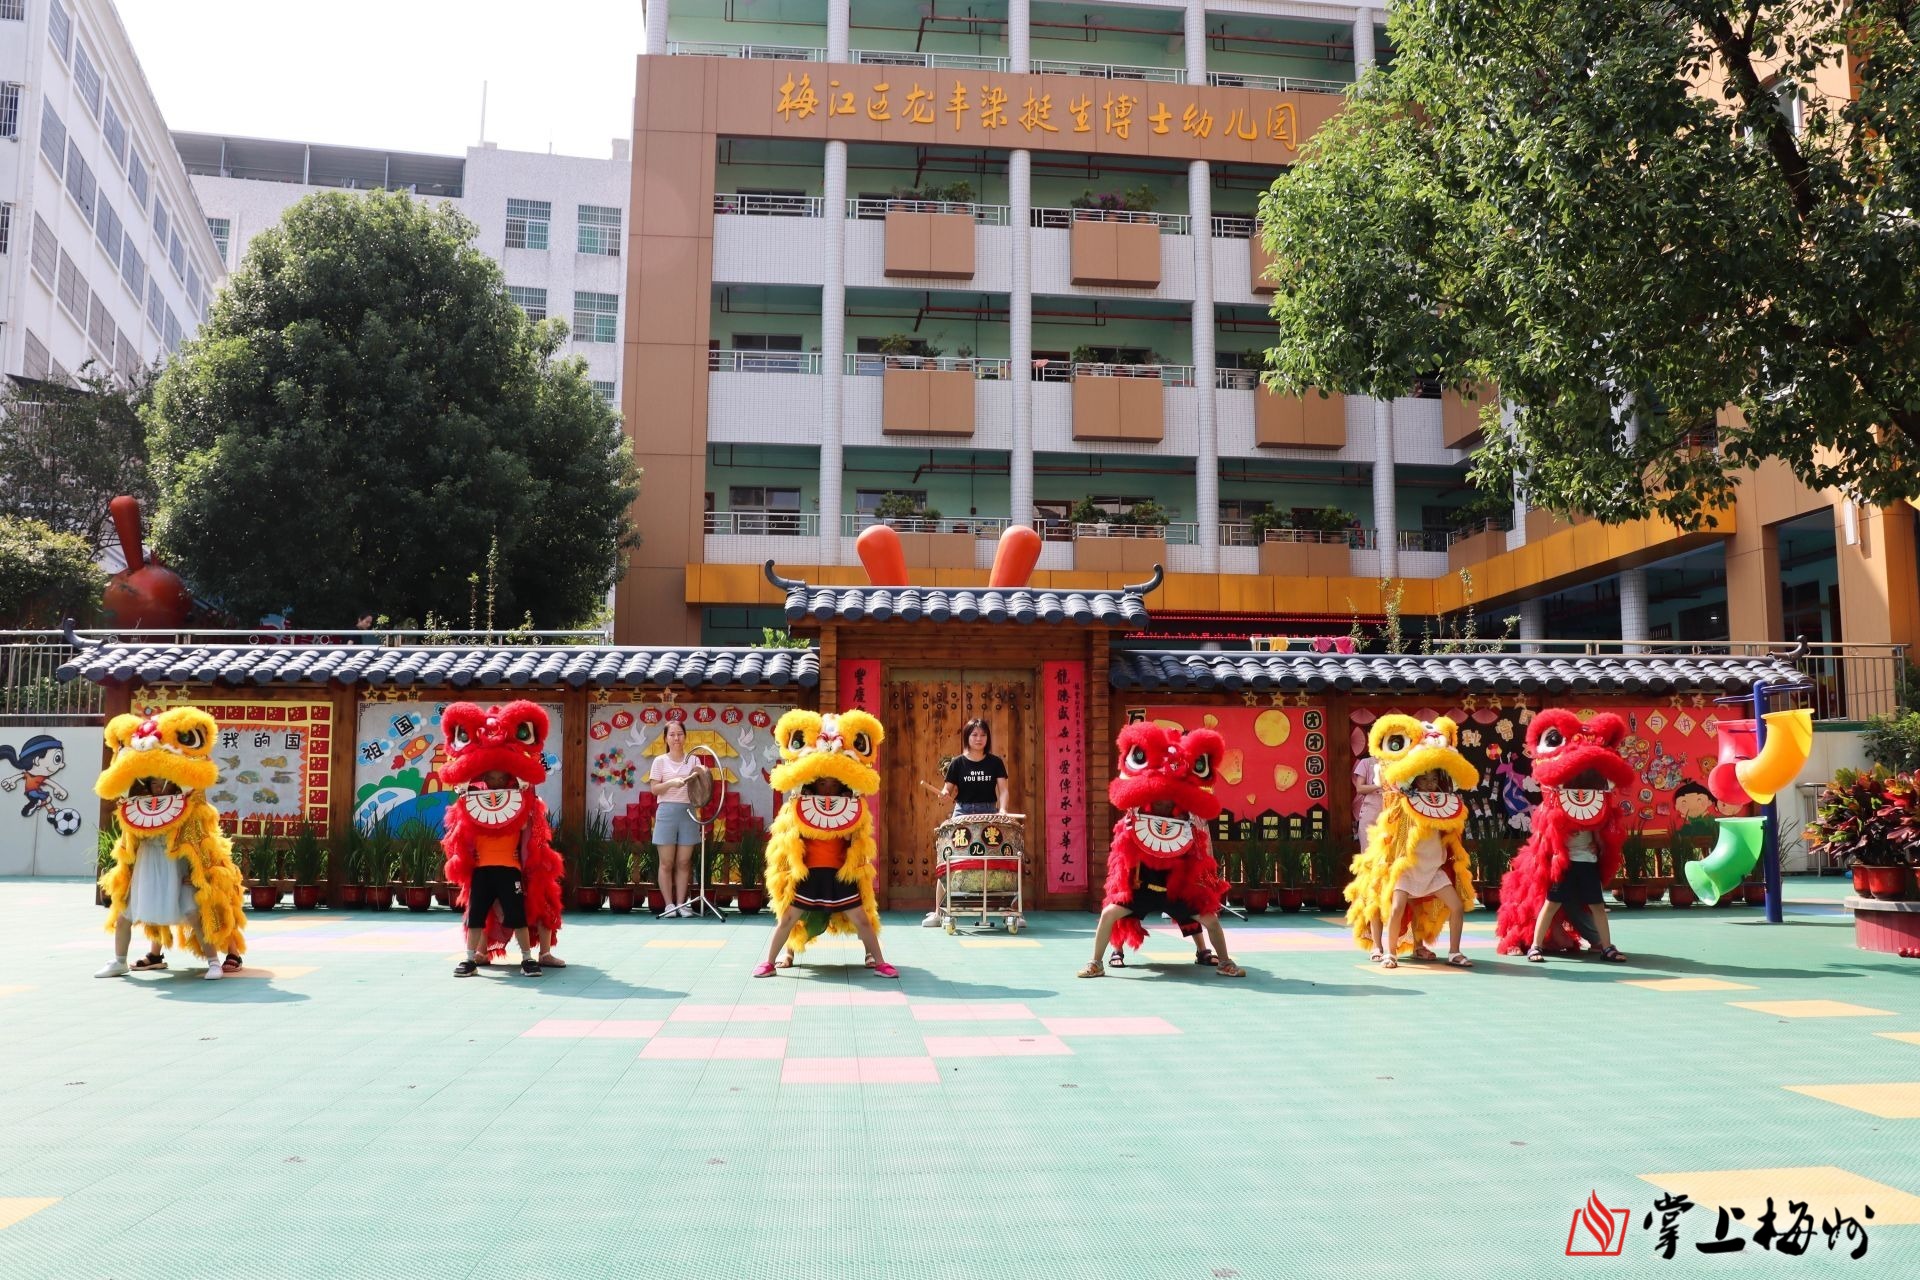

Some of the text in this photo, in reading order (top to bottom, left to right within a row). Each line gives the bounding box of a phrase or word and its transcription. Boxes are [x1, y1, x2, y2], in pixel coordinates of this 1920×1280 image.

[777, 73, 1297, 149] 梅江区龙丰梁挺生博士幼儿园
[223, 732, 301, 750] 我的国
